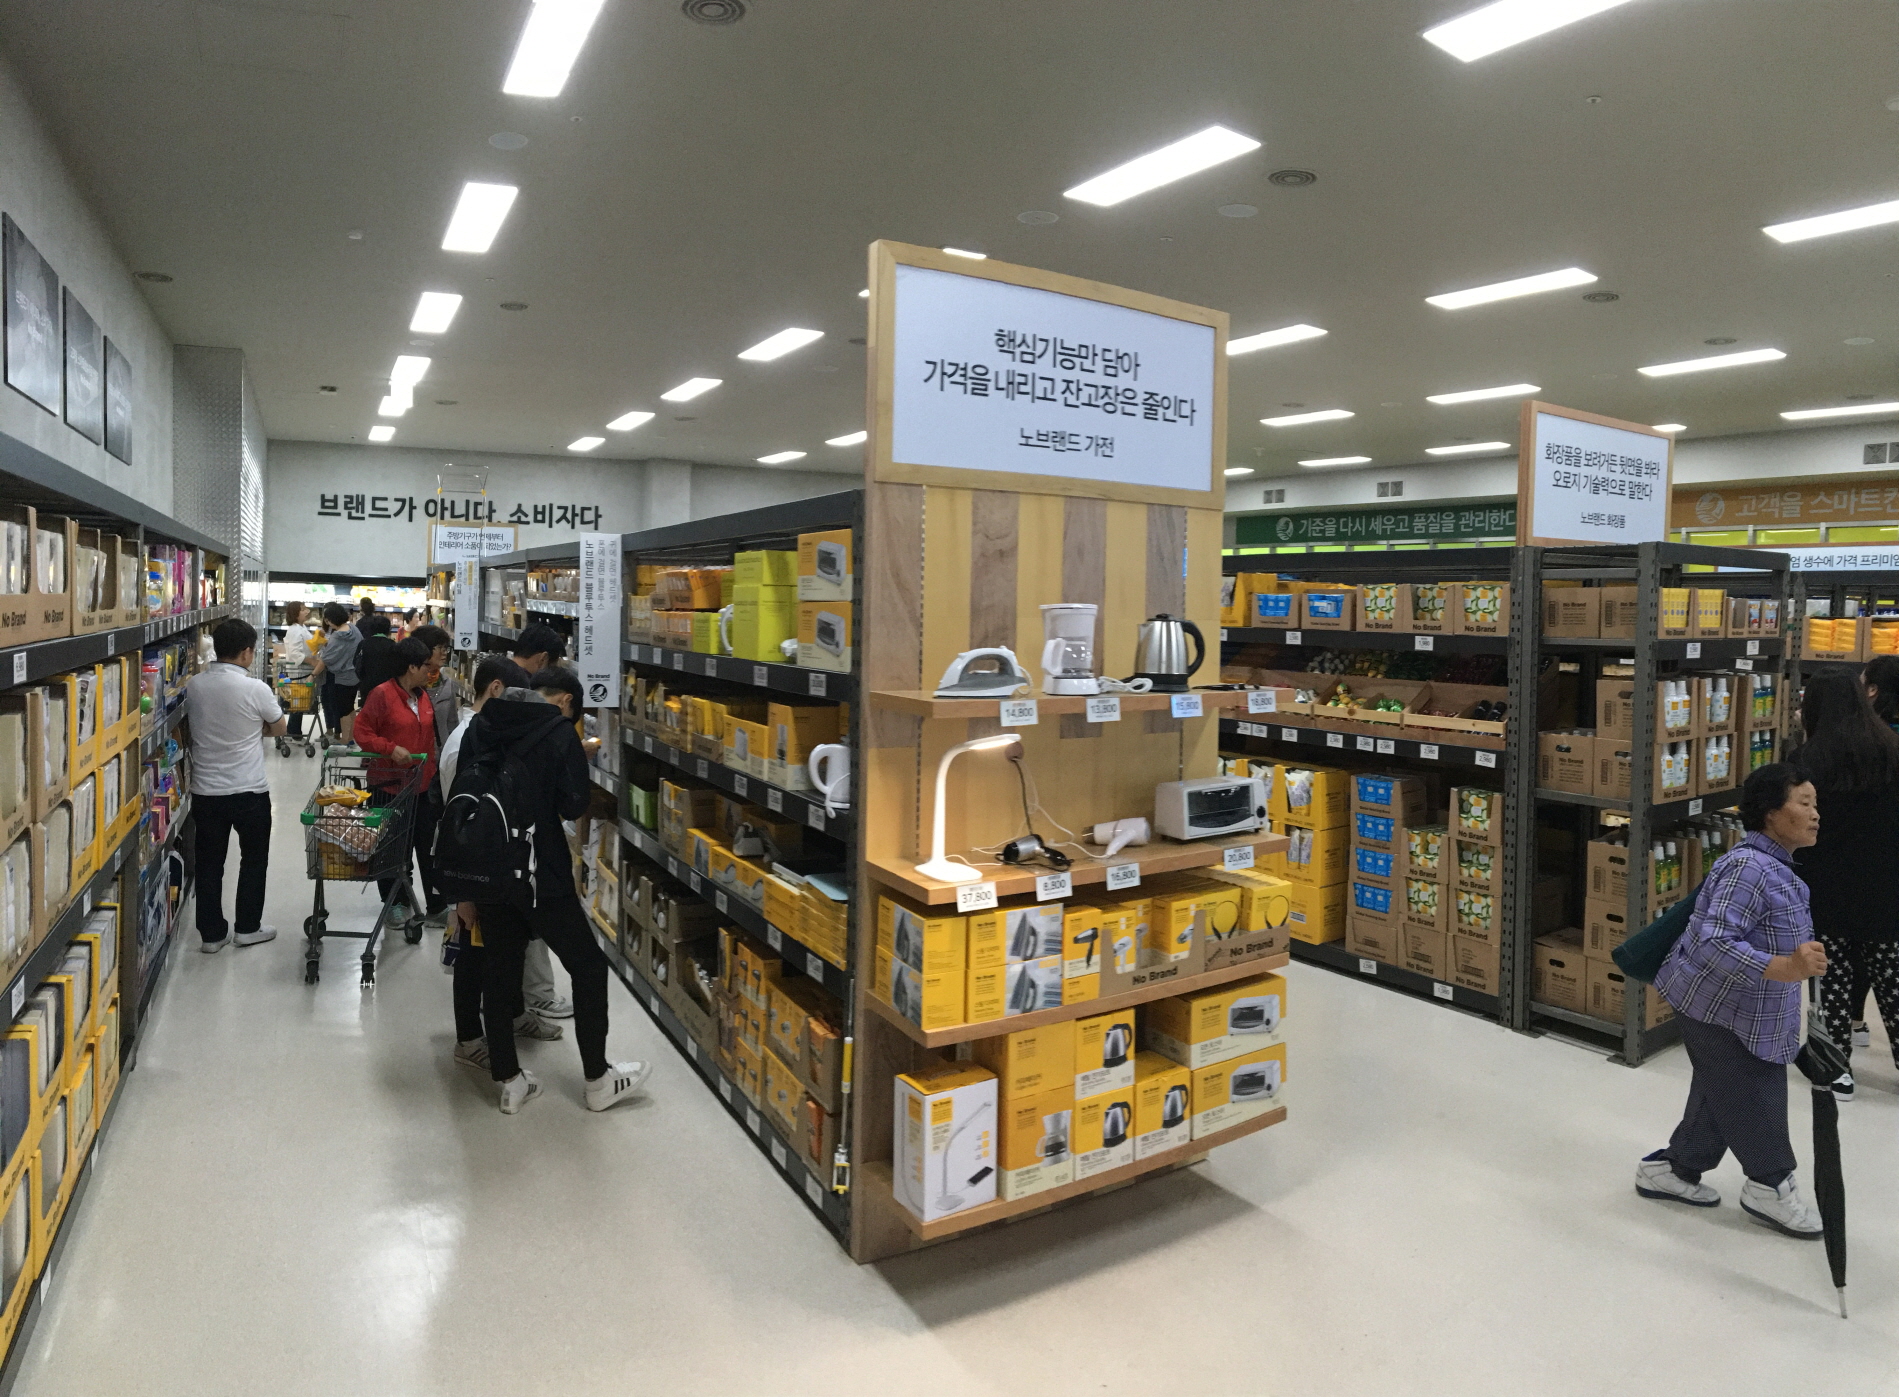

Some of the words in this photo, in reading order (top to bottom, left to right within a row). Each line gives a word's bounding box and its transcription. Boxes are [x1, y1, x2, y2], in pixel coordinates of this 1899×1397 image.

[994, 328, 1098, 374] 핵심기능만
[1101, 346, 1140, 381] 담아
[923, 359, 990, 397] 가격을
[994, 369, 1057, 403] 내리고
[1061, 377, 1138, 418] 잔고장은
[1141, 391, 1197, 427] 줄인다
[1018, 427, 1084, 453] 노브랜드
[1085, 435, 1115, 458] 가전
[1545, 442, 1582, 468] 화장품을
[1584, 450, 1618, 473] 보려거든
[1619, 456, 1644, 478] 뒷면을
[1644, 460, 1660, 480] 봐라
[1552, 470, 1581, 492] 오로지
[1582, 474, 1626, 496] 기술력으로
[1628, 480, 1653, 502] 말한다
[1736, 491, 1804, 518] 고객을
[317, 493, 417, 522] 브랜드가
[507, 503, 603, 530] 소비자다
[1298, 517, 1336, 538] 기준을
[1338, 516, 1366, 536] 다시
[1368, 514, 1410, 536] 세우고
[1412, 512, 1456, 534] 품질을
[1580, 512, 1606, 526] 노브랜드
[1607, 514, 1626, 528] 화장품
[446, 531, 478, 540] 주방기구가
[438, 541, 464, 550] 인테리어
[585, 540, 594, 578] 노브랜드
[1803, 554, 1834, 568] 생수에
[1836, 554, 1858, 568] 가격
[584, 582, 594, 622] 블루투스
[2, 612, 10, 628] No
[11, 610, 26, 626] Brand
[44, 610, 50, 624] No
[52, 608, 64, 622] Brand
[584, 625, 594, 656] 헤드셋
[1090, 704, 1118, 714] 13,800
[1176, 701, 1199, 710] 15,800
[1005, 708, 1035, 718] 14,800
[1479, 756, 1493, 764] 2,980
[1672, 788, 1688, 796] Brand
[1470, 832, 1488, 842] Brand
[1228, 852, 1251, 862] 20,800
[458, 872, 490, 882] balance
[1420, 870, 1436, 878] Brand
[1460, 879, 1469, 887] No
[1471, 882, 1490, 892] Brand
[962, 890, 992, 904] 37,800
[1665, 894, 1680, 904] Brand
[1418, 918, 1434, 928] Brand
[1469, 930, 1488, 940] Brand
[1230, 946, 1243, 958] No
[1246, 938, 1274, 954] Brand
[1416, 964, 1434, 974] Brand
[1132, 975, 1148, 986] No
[1150, 966, 1178, 982] Brand
[1561, 974, 1576, 983] Brand
[1467, 978, 1486, 990] Brand
